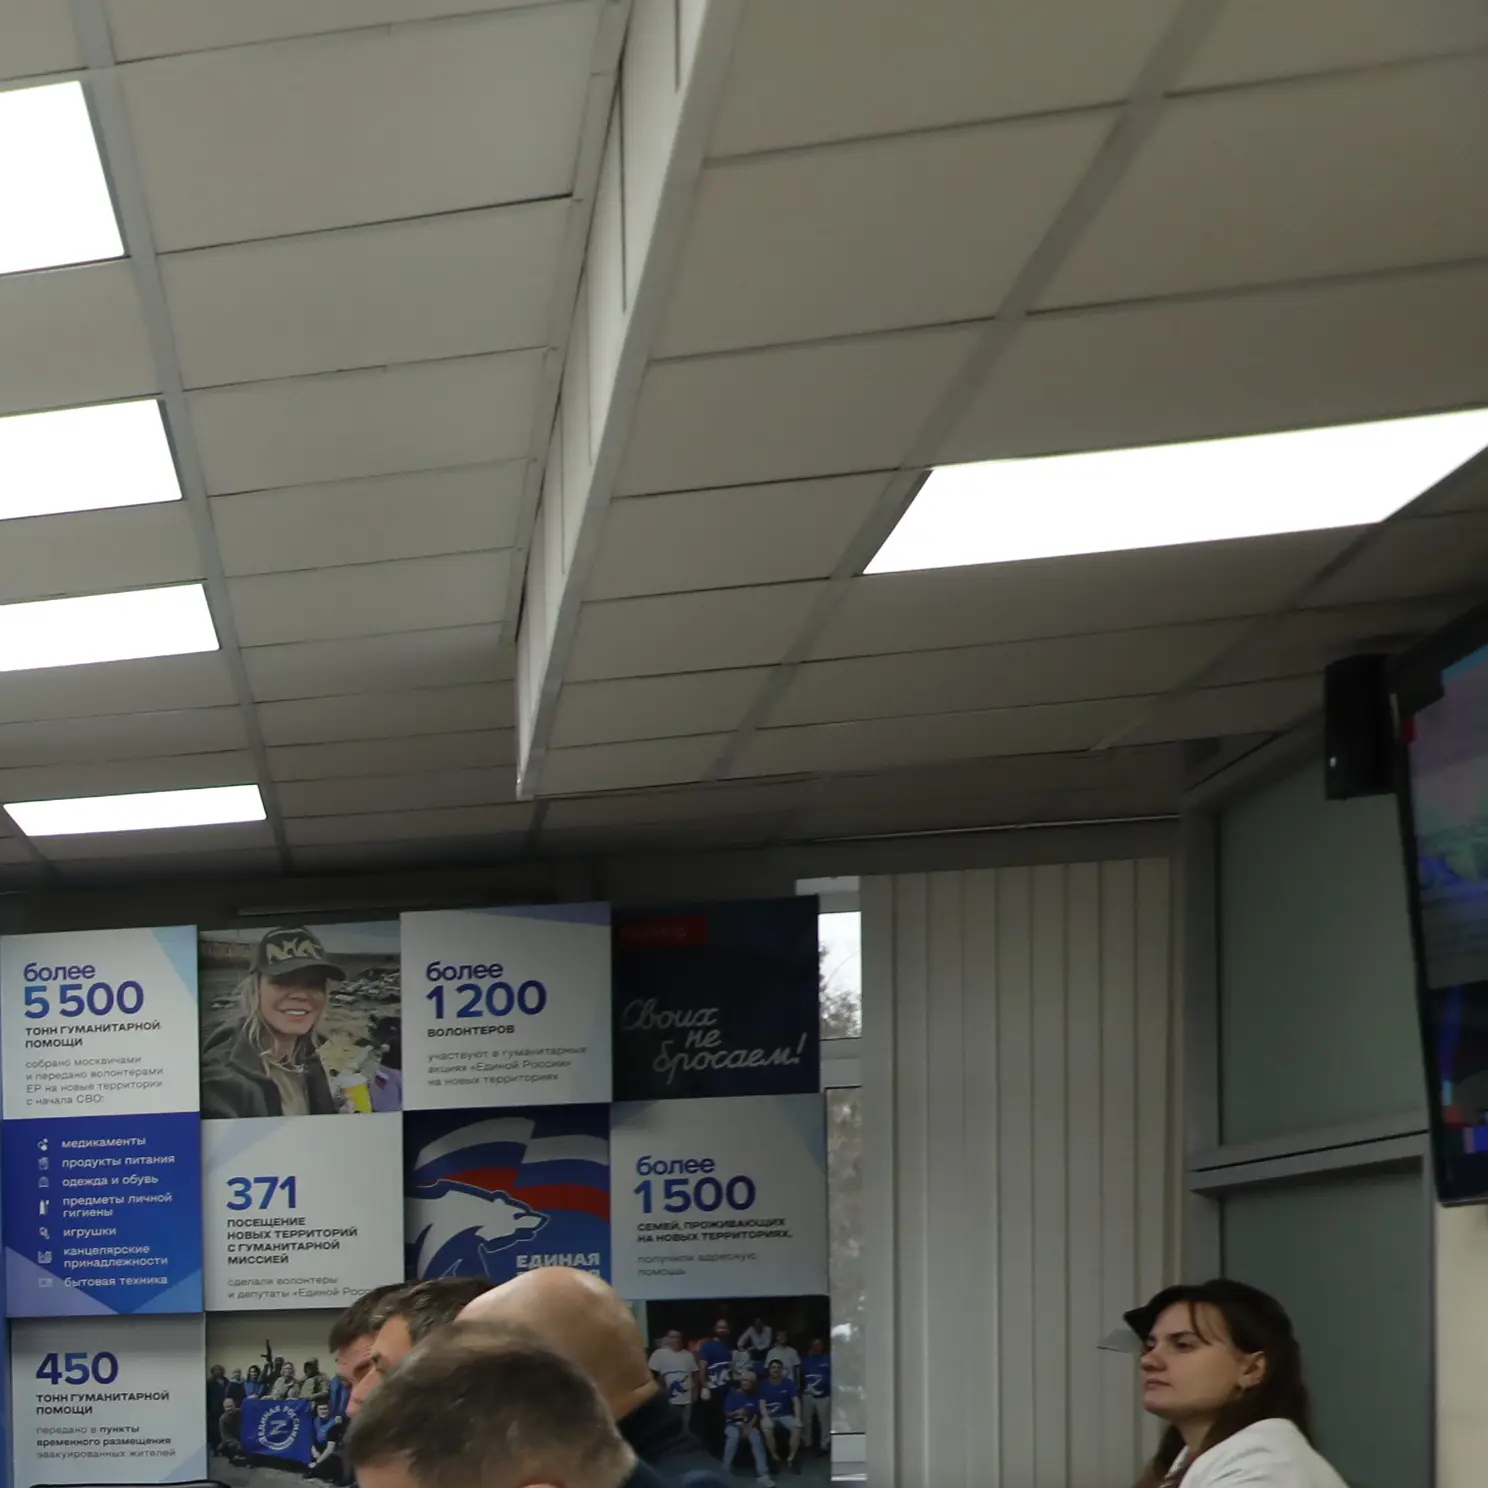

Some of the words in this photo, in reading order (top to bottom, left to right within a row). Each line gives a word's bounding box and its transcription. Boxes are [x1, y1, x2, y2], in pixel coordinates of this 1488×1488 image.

[24, 962, 96, 982] более
[426, 961, 504, 982] более
[621, 998, 719, 1031] Своих
[25, 1027, 58, 1036] ТОНН
[60, 1020, 161, 1035] ГУМАНИТАРНОЙ
[428, 1024, 515, 1037] ВОЛОНТЕРОВ
[25, 1038, 82, 1049] ПОМОЩИ
[684, 1029, 722, 1048] не
[428, 1051, 488, 1062] участвуют
[501, 1047, 587, 1058] гуманитарных
[653, 1032, 808, 1085] бросаем!
[25, 1058, 71, 1069] собрано
[74, 1056, 142, 1066] москвичами
[26, 1073, 33, 1081] и
[35, 1071, 88, 1082] передано
[91, 1068, 163, 1080] волонтерами
[26, 1084, 41, 1093] ЕР
[61, 1083, 94, 1092] новые
[98, 1080, 163, 1091] территории
[36, 1096, 73, 1105] начала
[62, 1137, 146, 1149] медикаменты
[62, 1157, 122, 1169] продукты
[124, 1155, 175, 1164] питания
[636, 1155, 715, 1176] более
[62, 1177, 108, 1187] одежда
[122, 1174, 159, 1186] обувь
[226, 1176, 296, 1210] 371
[62, 1195, 124, 1208] предметы
[127, 1192, 172, 1203] личной
[63, 1208, 113, 1218] гигиены
[227, 1217, 306, 1228] ПОСЕЩЕНИЕ
[684, 1218, 786, 1229] ПРОЖИВАЮЩИХ
[63, 1228, 117, 1238] игрушки
[228, 1231, 272, 1240] НОВЫХ
[276, 1226, 358, 1239] ТЕРРИТОРИЙ
[637, 1234, 653, 1242] НА
[656, 1233, 699, 1242] НОВЫХ
[64, 1246, 150, 1257] канцелярские
[228, 1244, 236, 1252] С
[239, 1240, 340, 1252] ГУМАНИТАРНОЙ
[64, 1258, 168, 1269] принадлежности
[228, 1253, 289, 1265] МИССИЕЙ
[516, 1253, 600, 1268] ЕДИНАЯ
[64, 1276, 115, 1288] бытовая
[120, 1276, 168, 1284] техника
[228, 1278, 273, 1286] сделали
[277, 1277, 338, 1285] волонтеры
[237, 1291, 289, 1300] депутаты
[36, 1351, 119, 1385] 450
[36, 1394, 68, 1403] ТОНН
[70, 1390, 169, 1401] ГУМАНИТАРНОЙ
[36, 1406, 93, 1415] ПОМОЩИ
[36, 1426, 87, 1435] передано
[99, 1425, 140, 1435] пункты
[37, 1438, 100, 1447] временного
[103, 1437, 171, 1447] размещения
[36, 1451, 126, 1460] эвакуированных
[129, 1449, 176, 1457] жителей
